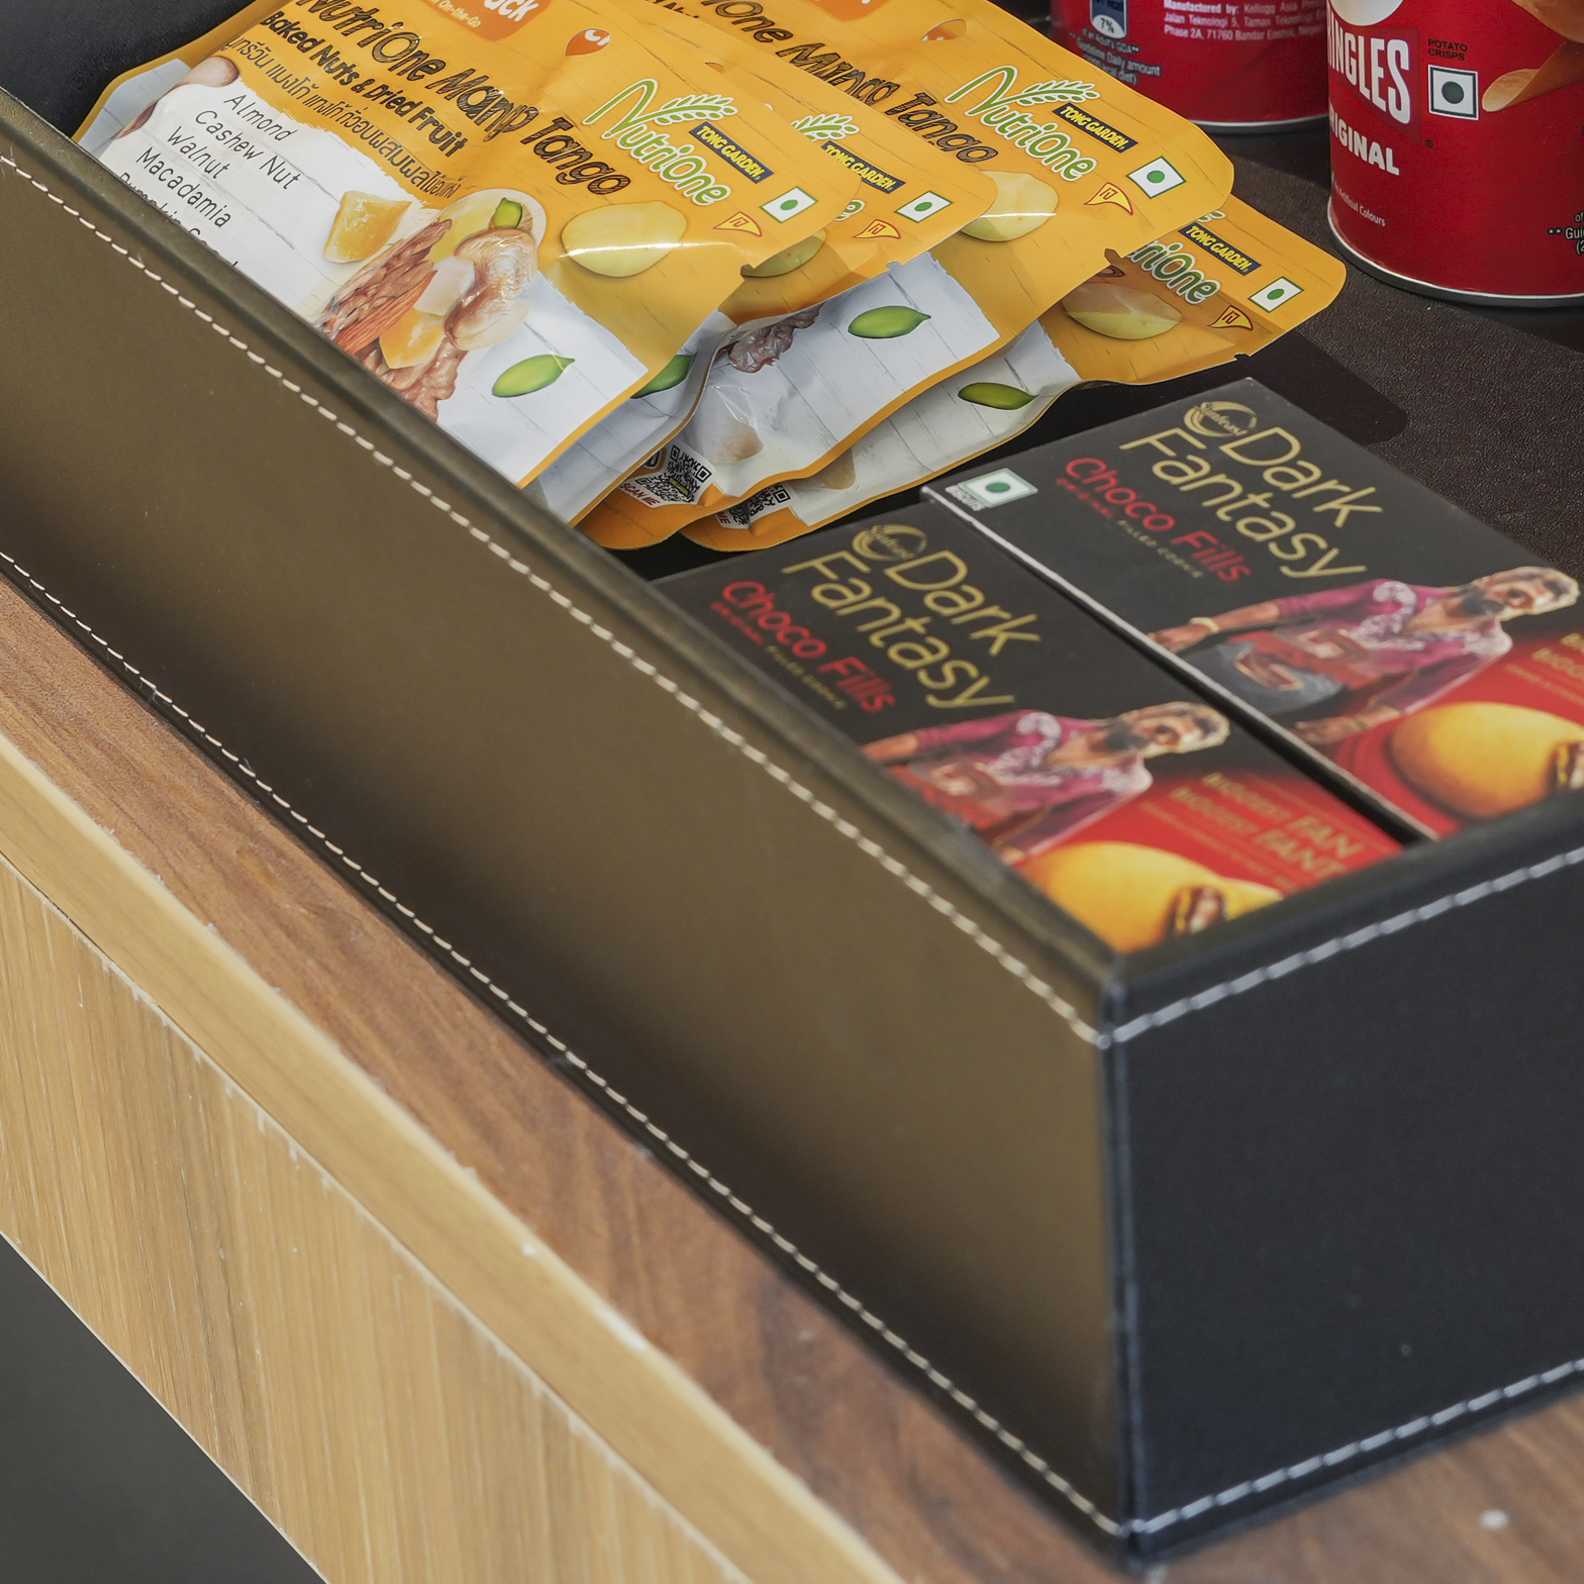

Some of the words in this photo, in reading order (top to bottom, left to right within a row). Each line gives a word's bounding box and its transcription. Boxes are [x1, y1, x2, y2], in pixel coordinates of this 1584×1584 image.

[259, 10, 326, 54] Baked
[438, 0, 482, 28] On-the-Go
[1099, 17, 1115, 34] 7%
[309, 44, 360, 86] Nuts
[1127, 60, 1161, 77] amount
[1427, 38, 1469, 53] POTATO
[1427, 48, 1466, 62] CRISPS
[350, 78, 376, 94] &
[361, 84, 424, 117] Dried
[223, 94, 298, 142] Almond
[407, 106, 468, 158] Fruit
[886, 93, 999, 164] Tango
[1059, 105, 1092, 130] TONG
[1085, 121, 1128, 151] GARDEN
[1329, 101, 1400, 176] RIGINAL
[166, 125, 231, 180] Walnut
[195, 110, 264, 161] Cashew
[259, 155, 301, 190] Nut
[521, 116, 632, 196] Tango
[696, 124, 726, 153] TONG
[718, 145, 766, 182] GARDEN
[825, 143, 857, 169] TONG
[848, 162, 897, 191] GARDEN
[135, 146, 232, 228] Macadamia
[1358, 202, 1386, 227] Colours
[1574, 210, 1584, 223] of
[1130, 241, 1220, 305] riOne
[1186, 225, 1216, 247] TONG
[1210, 242, 1252, 273] GARDEN
[619, 482, 642, 499] SCAN
[641, 494, 661, 506] ME
[1218, 425, 1383, 531] Dark
[1065, 456, 1176, 532] Choco
[1170, 529, 1252, 582] Fills
[1118, 426, 1367, 580] Fantasy
[889, 550, 1042, 657] Dark
[722, 580, 827, 659] Choco
[818, 655, 896, 713] Fills
[782, 550, 1015, 710] Fantasy
[1285, 814, 1365, 858] FAN
